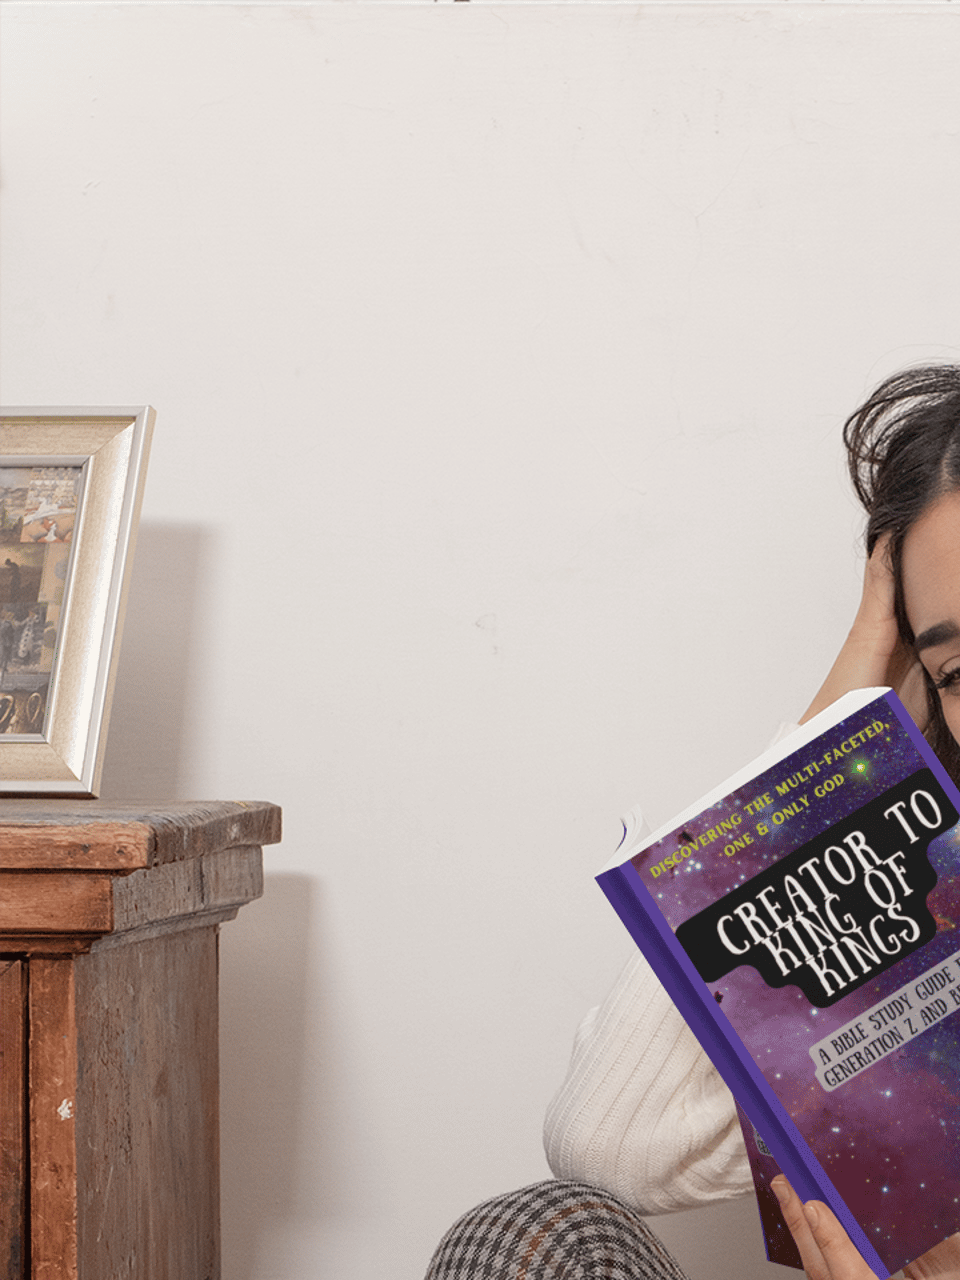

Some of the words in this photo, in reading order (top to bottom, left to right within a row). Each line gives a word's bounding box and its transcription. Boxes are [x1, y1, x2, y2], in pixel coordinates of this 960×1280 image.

[649, 812, 742, 879] DISCOVERING
[743, 791, 774, 816] THE
[775, 720, 890, 796] MULTI-FACETED,
[723, 832, 755, 857] ONE
[755, 821, 769, 836] &
[771, 794, 811, 826] ONLY
[814, 773, 845, 798] GOD
[717, 830, 883, 955] CREATOR
[883, 789, 942, 844] TO
[761, 893, 858, 976] KING
[864, 851, 914, 909] OF
[805, 903, 920, 997] KINGS
[818, 1048, 831, 1066] A
[830, 1022, 869, 1056] BIBLE
[868, 992, 914, 1031] STUDY
[914, 966, 956, 1001] GUIDE
[823, 1026, 905, 1087] GENERATION
[903, 1017, 918, 1035] Z
[919, 998, 948, 1027] AND
